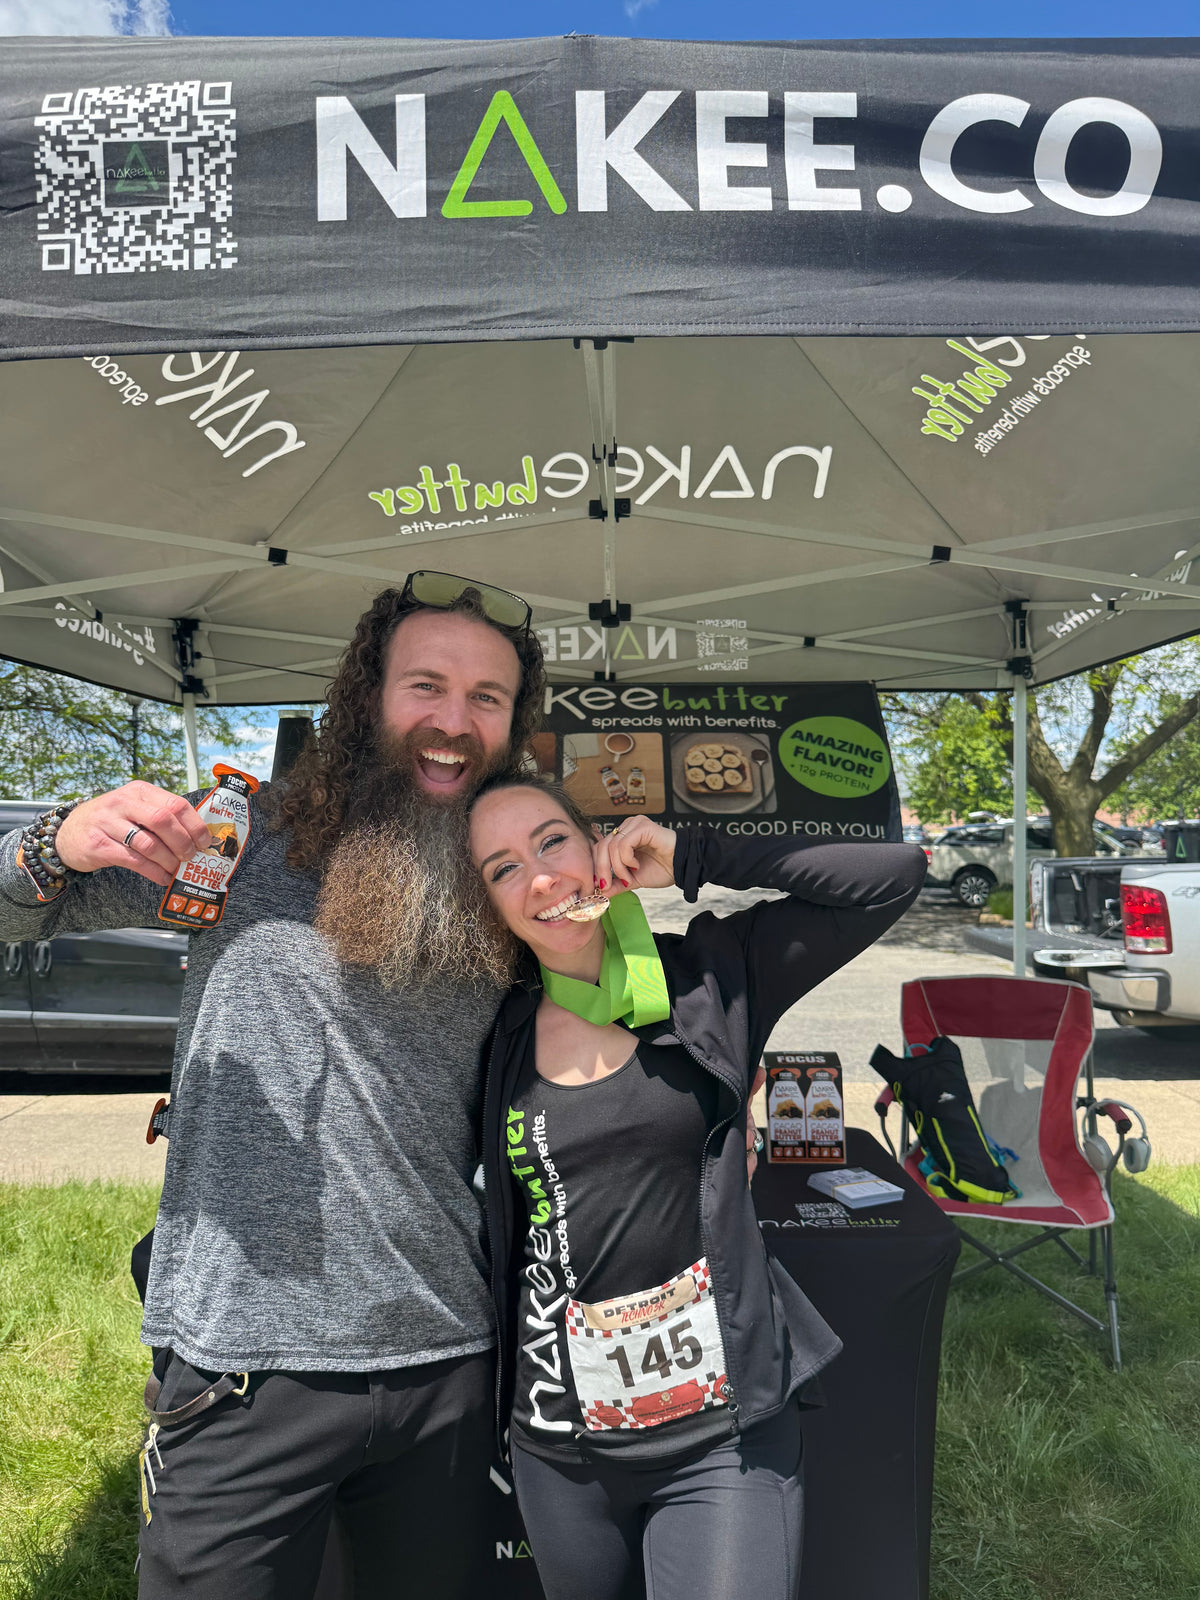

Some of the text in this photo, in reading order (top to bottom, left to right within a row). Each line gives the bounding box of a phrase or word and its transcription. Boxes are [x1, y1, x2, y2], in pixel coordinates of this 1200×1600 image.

[316, 89, 1163, 221] NAKEE.CO
[591, 715, 663, 729] spreads
[666, 715, 701, 727] with
[790, 729, 884, 764] AMAZING
[793, 745, 875, 779] FLAVOR!
[227, 775, 248, 789] FOCUS
[819, 769, 871, 792] PROTEIN
[208, 801, 235, 819] butter
[725, 820, 788, 836] GOOD
[792, 820, 833, 836] FOR
[835, 822, 886, 839] YOU!
[182, 870, 222, 891] BUTTER
[186, 862, 226, 882] PEANUT
[182, 885, 199, 895] FOCUS
[776, 1055, 826, 1064] FOCUS
[553, 1183, 567, 1218] with
[555, 1218, 579, 1290] spreads
[603, 1287, 676, 1319] DETROIT
[605, 1318, 703, 1388] 145
